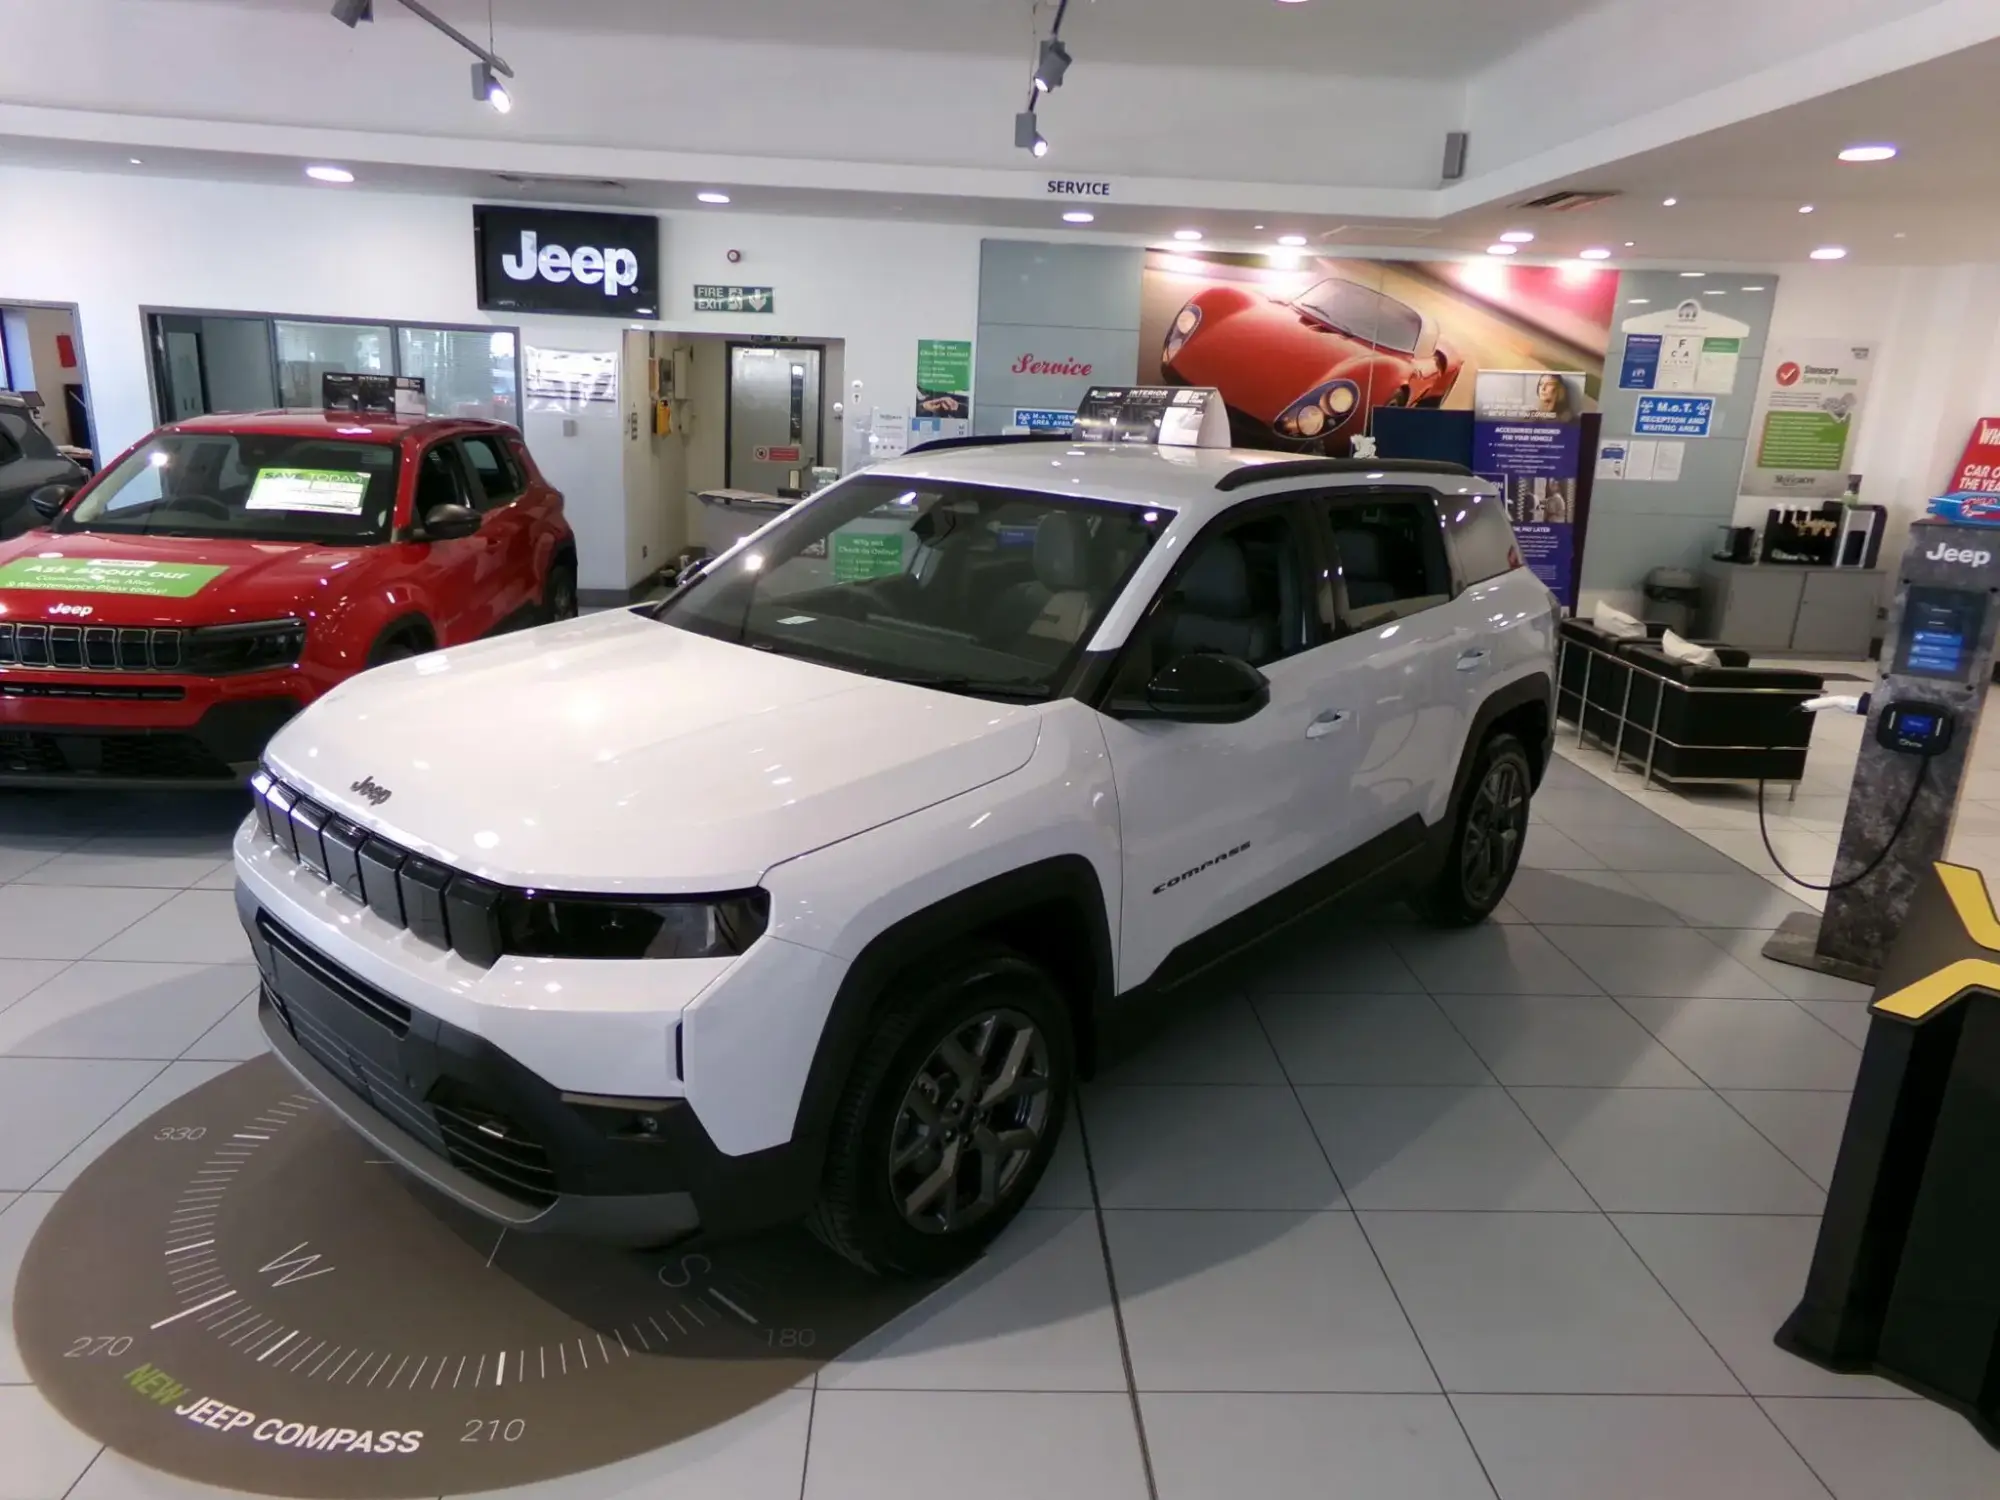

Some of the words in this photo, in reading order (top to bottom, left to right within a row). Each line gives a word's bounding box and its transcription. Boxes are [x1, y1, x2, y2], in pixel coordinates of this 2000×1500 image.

[1047, 180, 1111, 196] SERVICE
[501, 230, 638, 296] Jeep
[698, 287, 724, 298] FIRE
[698, 299, 724, 310] EXIT
[1011, 353, 1093, 377] Service
[1127, 389, 1169, 398] INTERIOR
[1656, 402, 1693, 413] M.o.T.
[1032, 419, 1050, 427] AREA
[1640, 415, 1686, 424] RECEPTION
[1687, 417, 1707, 425] AND
[1642, 424, 1677, 432] WAITING
[1678, 425, 1701, 433] AREA
[1964, 464, 1991, 478] CAR
[1959, 477, 1981, 489] THE
[1926, 543, 1991, 568] Jeep
[24, 565, 70, 574] Ask
[73, 567, 145, 577] about
[148, 570, 191, 579] our
[48, 603, 93, 616] Jeep
[350, 775, 392, 806] Jeep
[1152, 840, 1250, 895] COMPASS
[153, 1126, 208, 1142] 330
[257, 1241, 336, 1288] W
[658, 1254, 712, 1288] S
[764, 1328, 817, 1348] 180
[63, 1335, 134, 1359] 270
[123, 1362, 191, 1406] NEW
[174, 1396, 256, 1431] JEEP
[251, 1417, 425, 1454] COMPASS
[460, 1418, 527, 1443] 210
